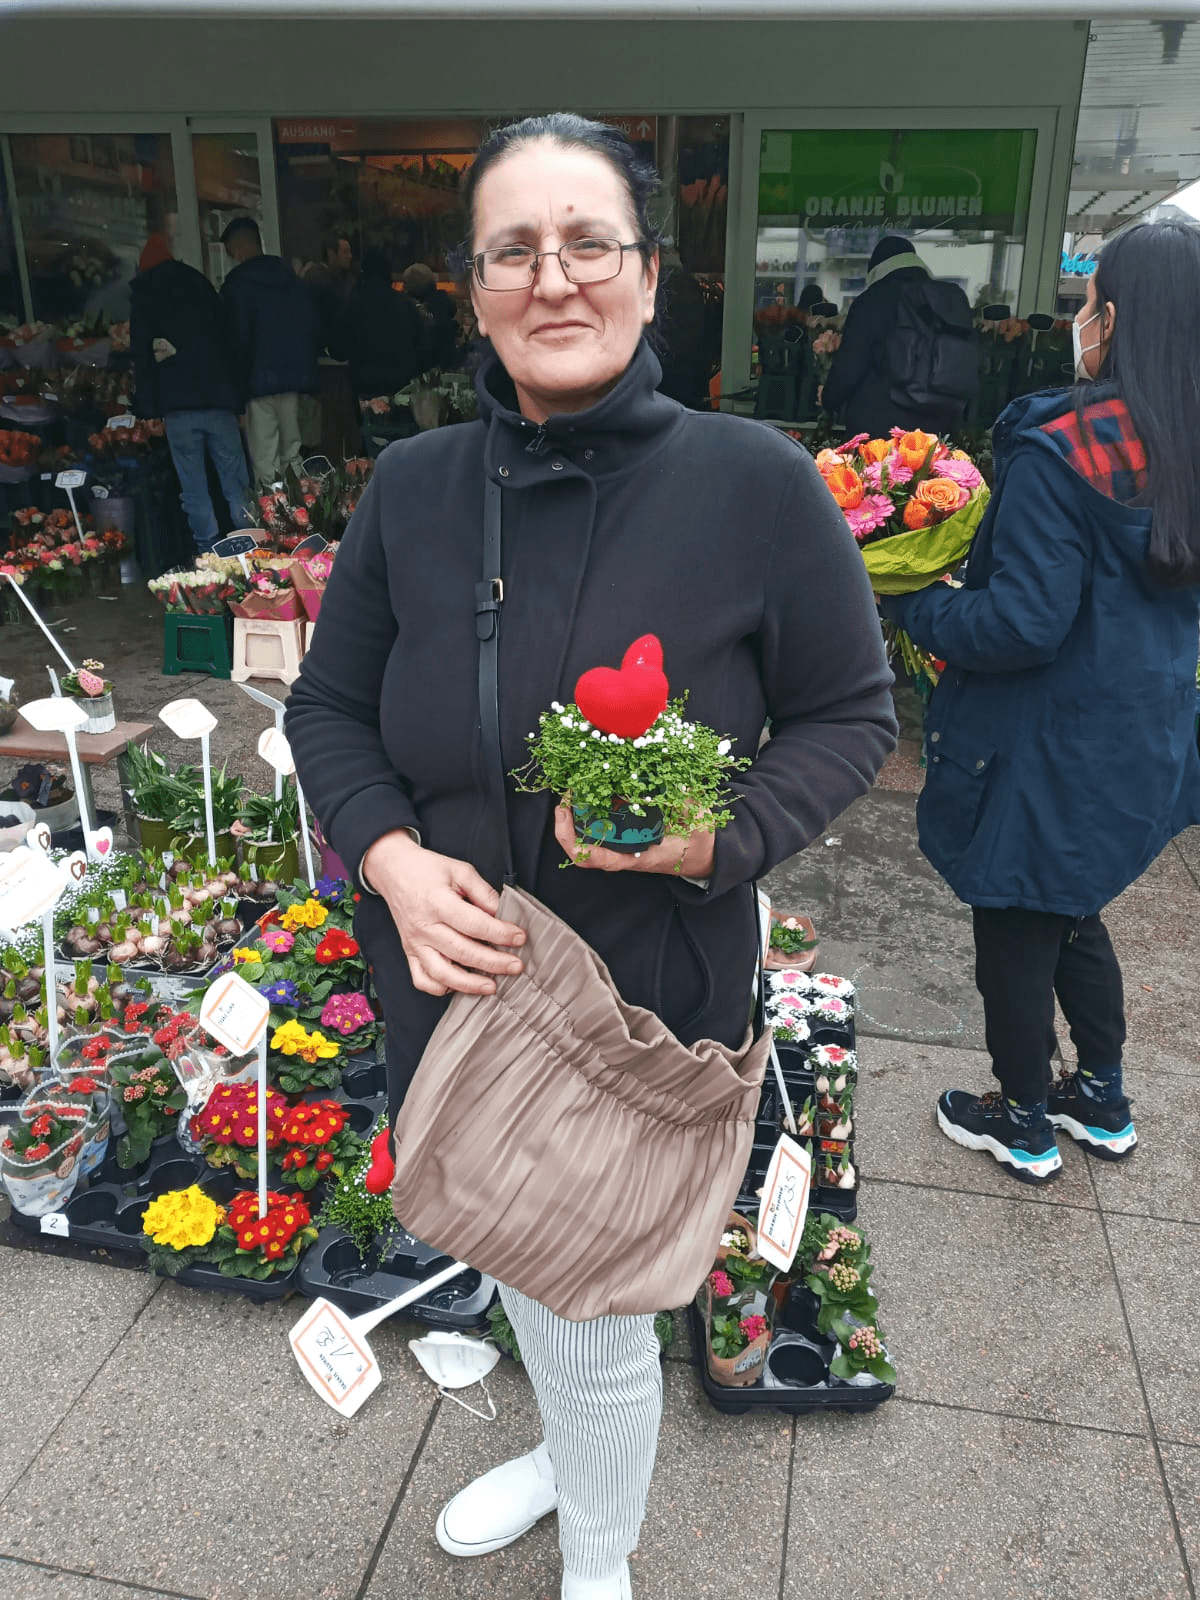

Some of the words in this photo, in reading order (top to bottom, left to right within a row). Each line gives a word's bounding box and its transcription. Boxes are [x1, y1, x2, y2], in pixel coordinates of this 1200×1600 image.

[282, 125, 336, 137] AUSGANG
[805, 195, 886, 217] ORANJE
[896, 195, 983, 217] BLUMEN
[49, 1217, 59, 1229] 2
